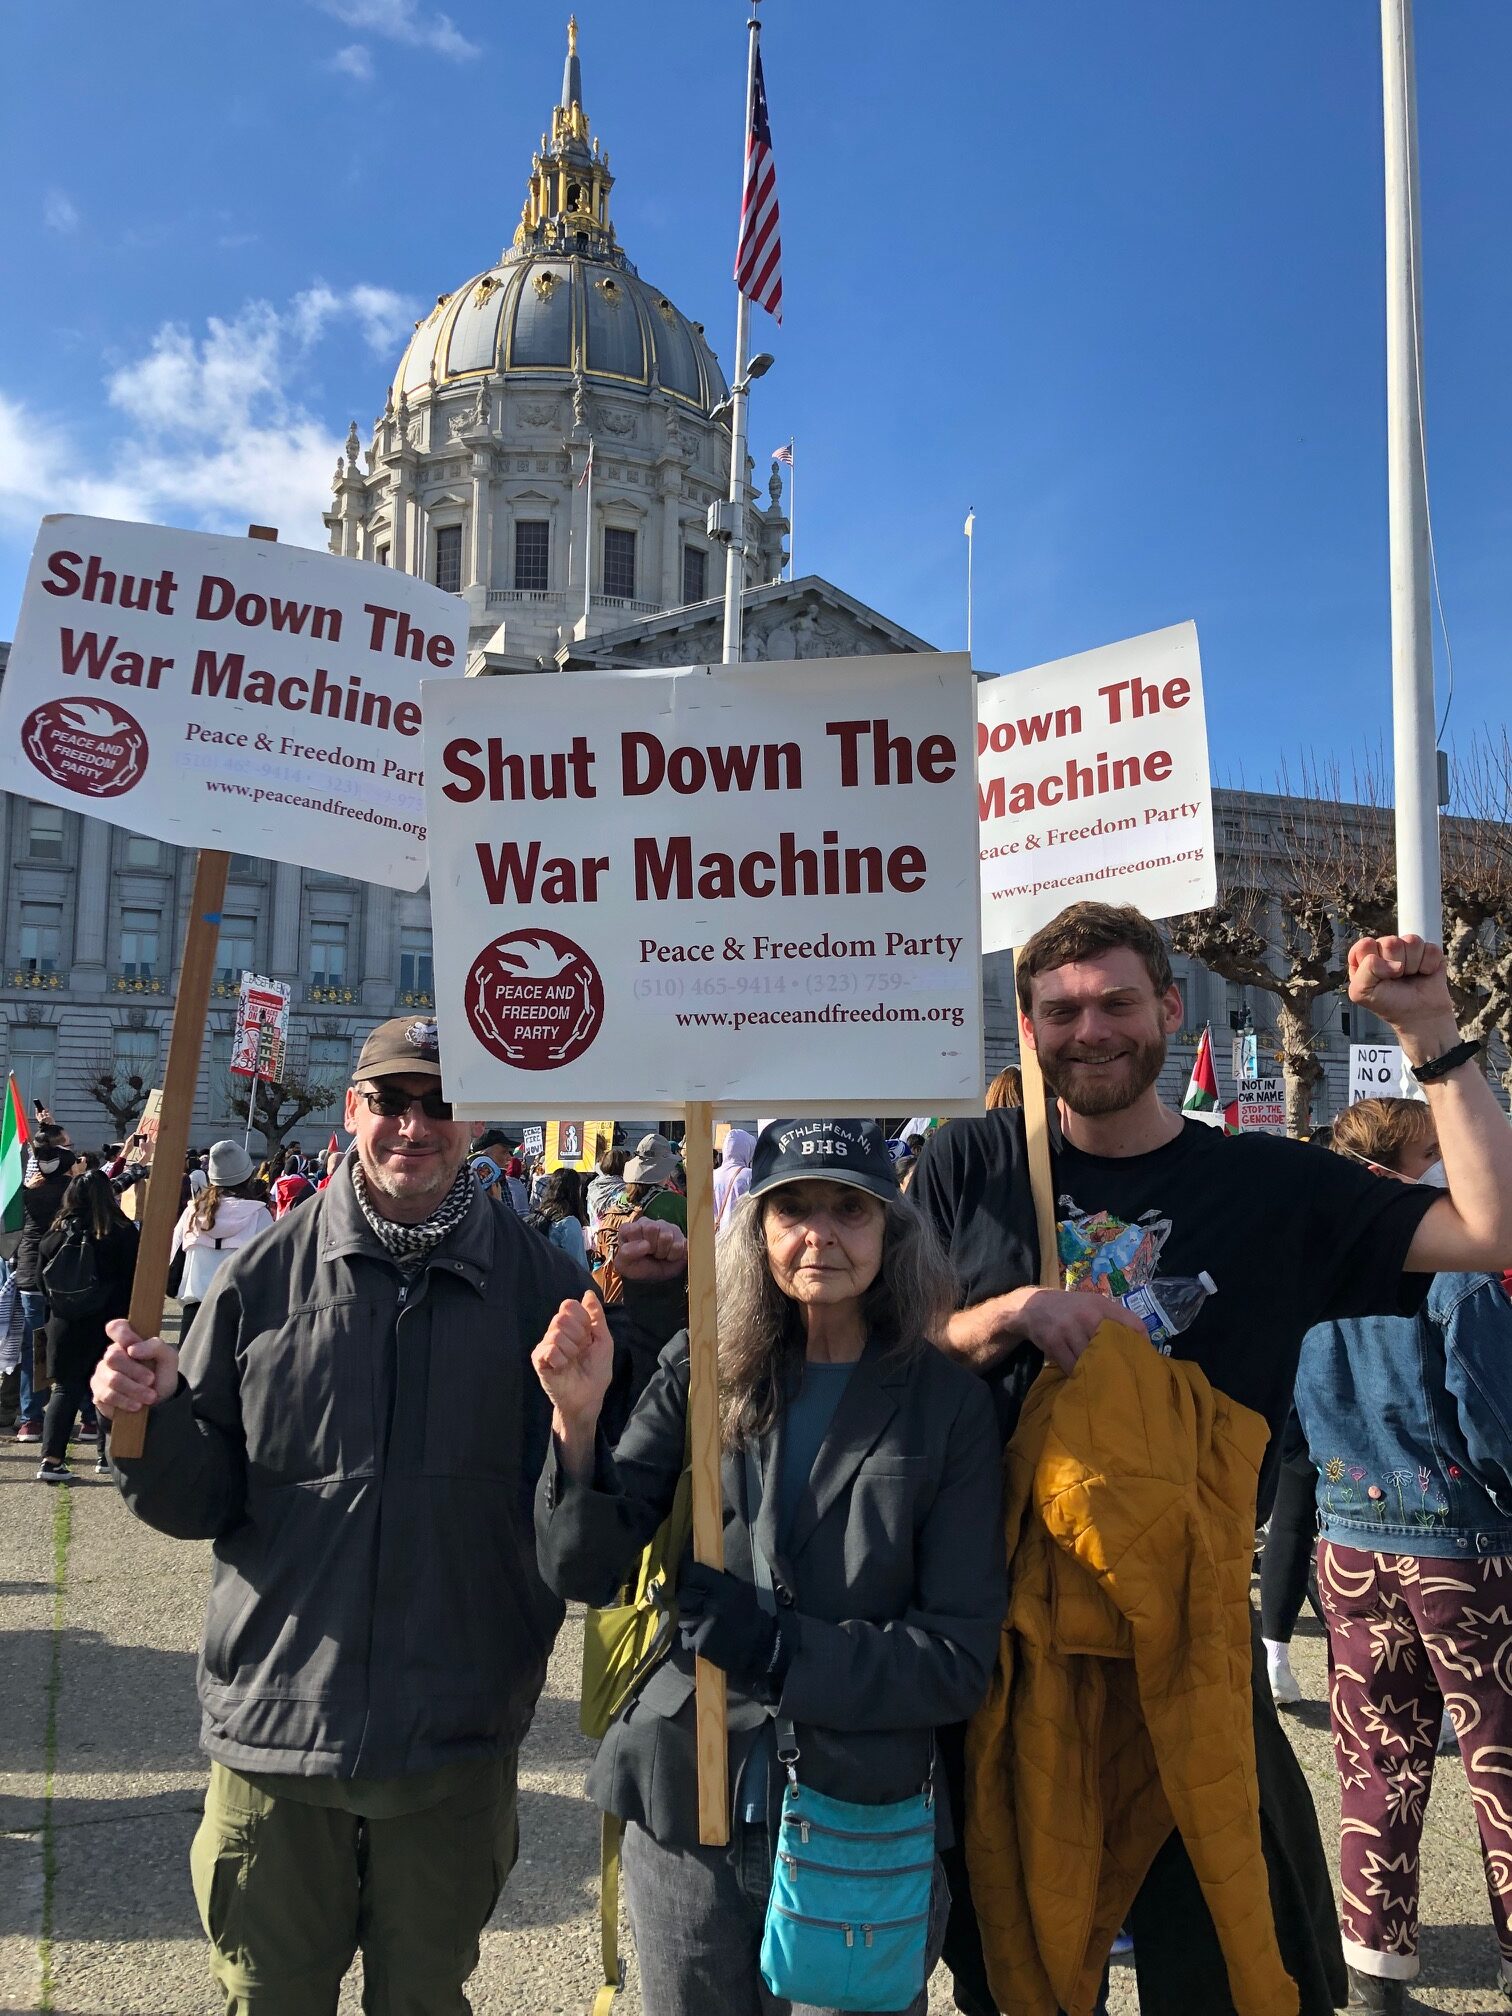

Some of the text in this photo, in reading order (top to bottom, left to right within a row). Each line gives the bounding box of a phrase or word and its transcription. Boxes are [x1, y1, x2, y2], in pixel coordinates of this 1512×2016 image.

[41, 550, 455, 668] Shut Down The
[60, 627, 422, 736] War Machine
[1098, 676, 1191, 724] The
[50, 729, 124, 756] PEACE AND
[184, 722, 424, 786] Peace & Freedom Part
[52, 744, 117, 770] FREEDOM
[61, 760, 104, 779] PARTY
[442, 719, 957, 803] Shut Down The
[978, 749, 1172, 822] Machine
[206, 780, 427, 841] www.peaceandfreedom.org
[980, 801, 1201, 861] eace & Freedom Party
[476, 830, 927, 905] War Machine
[992, 847, 1204, 900] www.peaceandfreedom.org
[639, 932, 963, 963] Peace & Freedom Party
[496, 985, 575, 1000] PEACE AND
[634, 978, 684, 1000] (510)
[691, 975, 786, 997] 465-9414
[806, 972, 858, 996] (323)
[502, 1006, 570, 1020] FREEDOM
[676, 1003, 964, 1030] www.peaceandfreedom.org
[514, 1025, 560, 1040] PARTY
[1358, 1050, 1392, 1063] NOT
[1242, 1080, 1276, 1090] NOT IN
[1256, 1091, 1284, 1102] NAME
[1242, 1105, 1282, 1114] STOP THE
[1242, 1114, 1285, 1124] GENOCIDE
[778, 1122, 872, 1155] BETHLEHEM, NH
[801, 1140, 848, 1156] BHS
